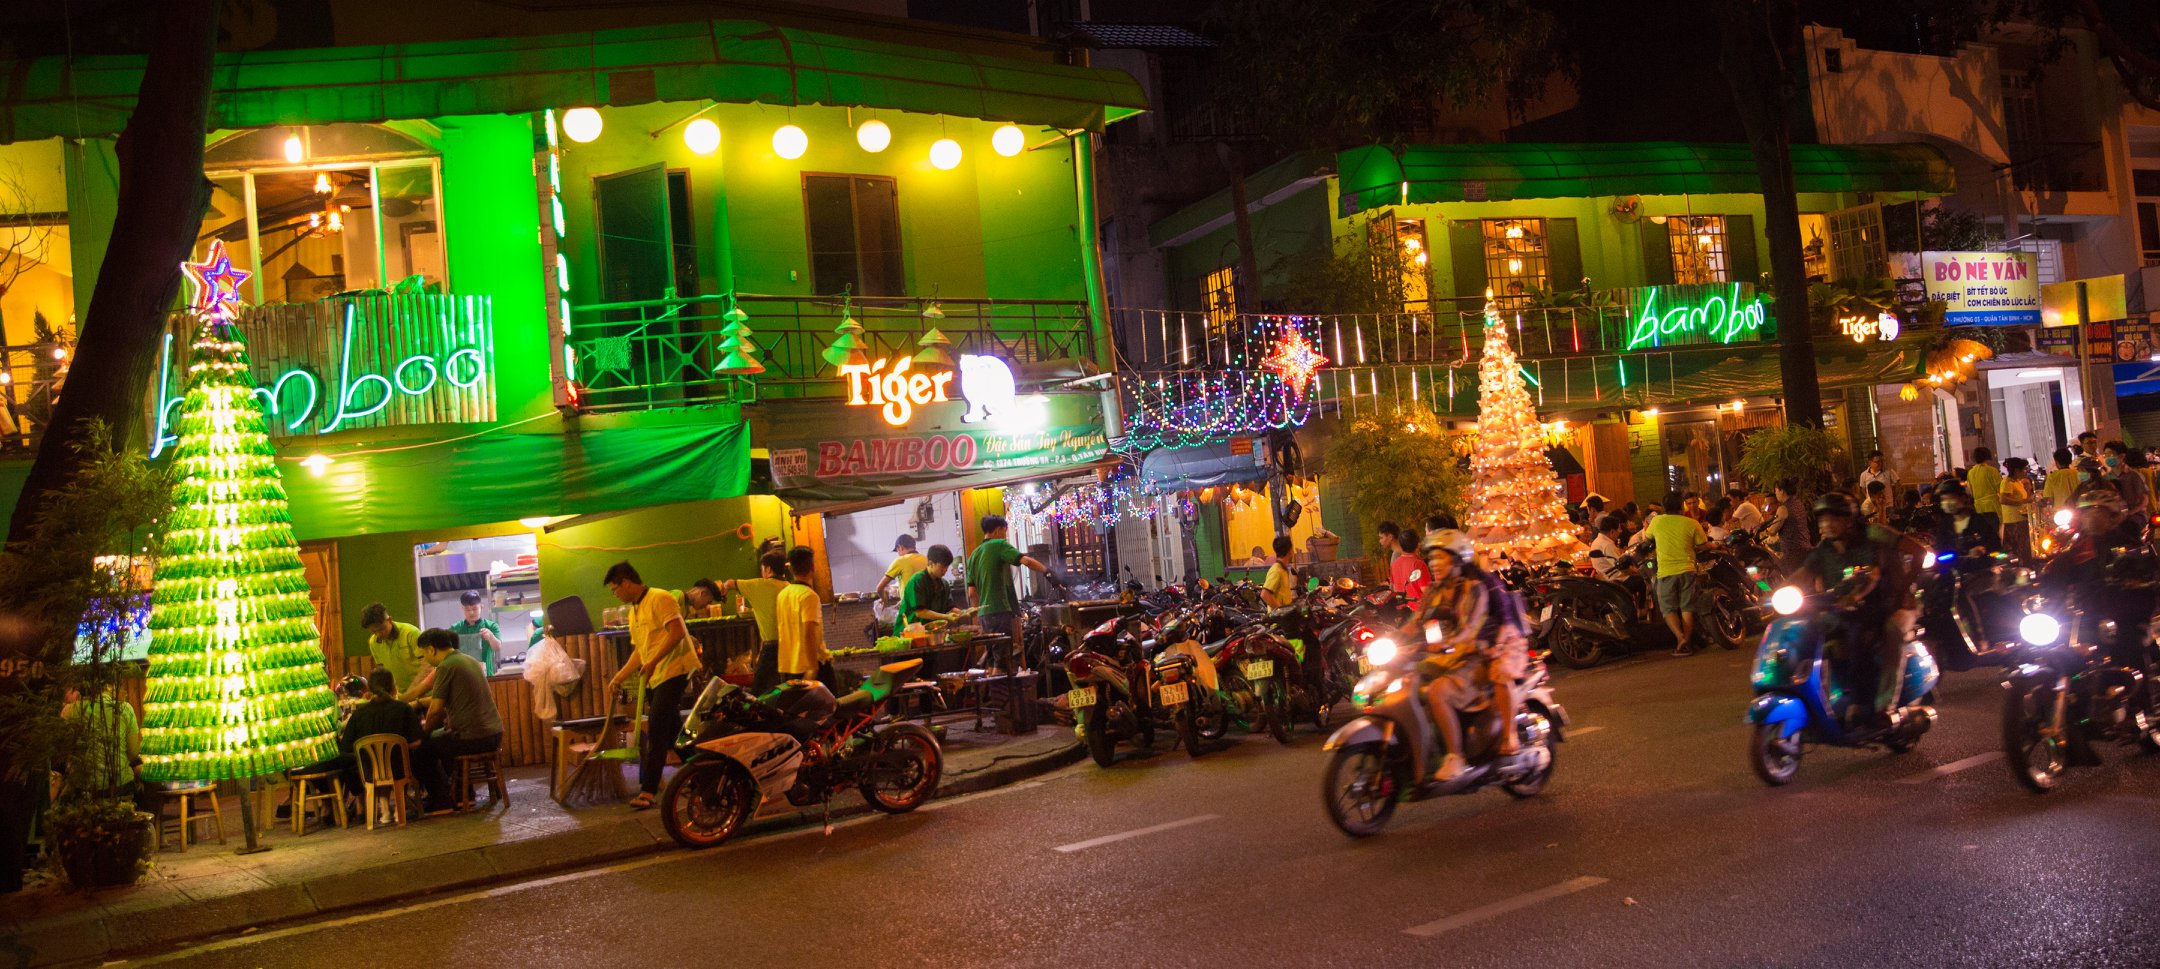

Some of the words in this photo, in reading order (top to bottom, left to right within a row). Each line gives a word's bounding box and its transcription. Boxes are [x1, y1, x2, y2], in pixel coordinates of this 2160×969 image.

[1935, 257, 1961, 281] BÒ
[1965, 257, 1988, 281] NÉ
[1991, 257, 2028, 281] VÂN
[1990, 286, 1998, 295] BÒ
[2002, 297, 2011, 306] BÒ
[1627, 282, 1764, 351] bamboo
[1839, 315, 1879, 343] Tiger
[840, 354, 953, 426] Tiger
[815, 433, 978, 478] BAMBOO
